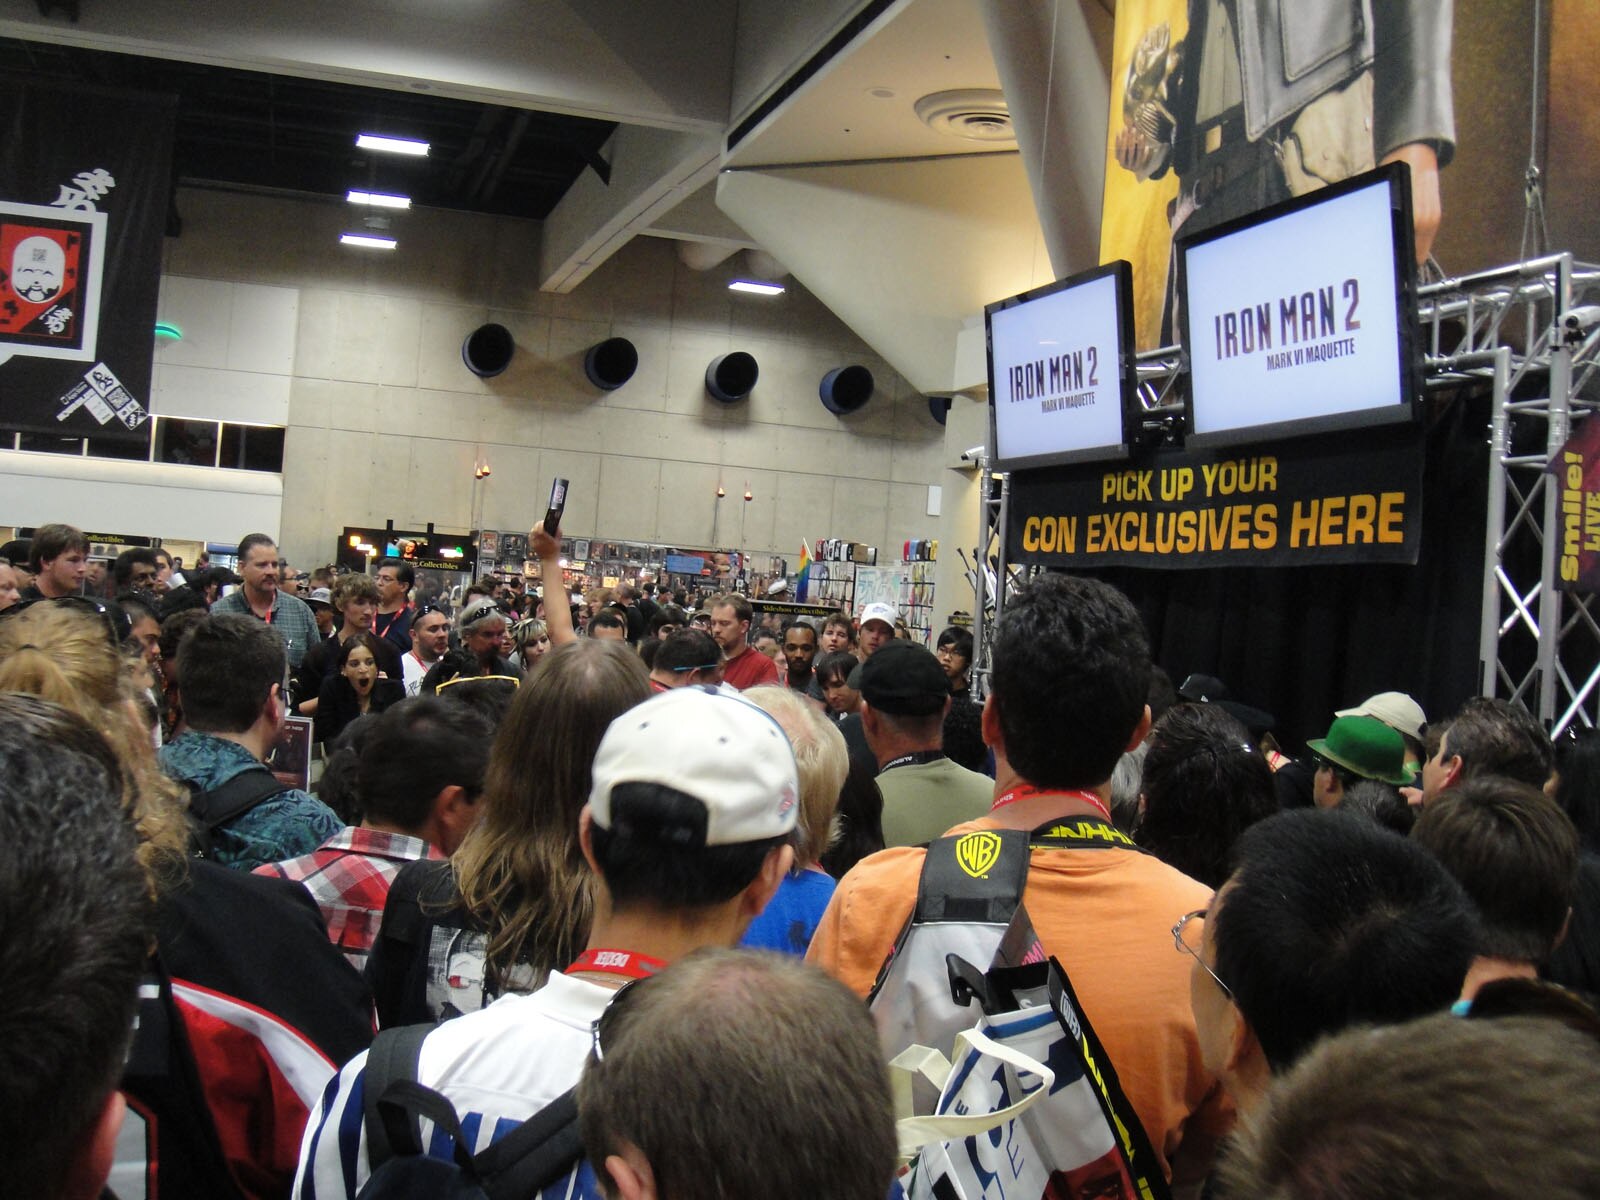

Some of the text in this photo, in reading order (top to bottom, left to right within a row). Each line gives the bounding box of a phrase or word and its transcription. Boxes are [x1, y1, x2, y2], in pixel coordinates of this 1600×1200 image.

[1215, 278, 1361, 361] IRON MAN 2
[1266, 337, 1356, 371] MARK VI MAQUETTE
[1009, 346, 1099, 403] IRON MAN 2
[1041, 391, 1096, 414] MARK VI MAQUETTE
[1101, 456, 1278, 504] PICK UP YOUR
[86, 535, 125, 544] ollectibles
[1022, 491, 1405, 554] CON EXCLUSIVES HERE
[419, 561, 459, 570] Collectibles
[762, 604, 829, 615] Sideshow Collectibles
[961, 834, 996, 872] WB
